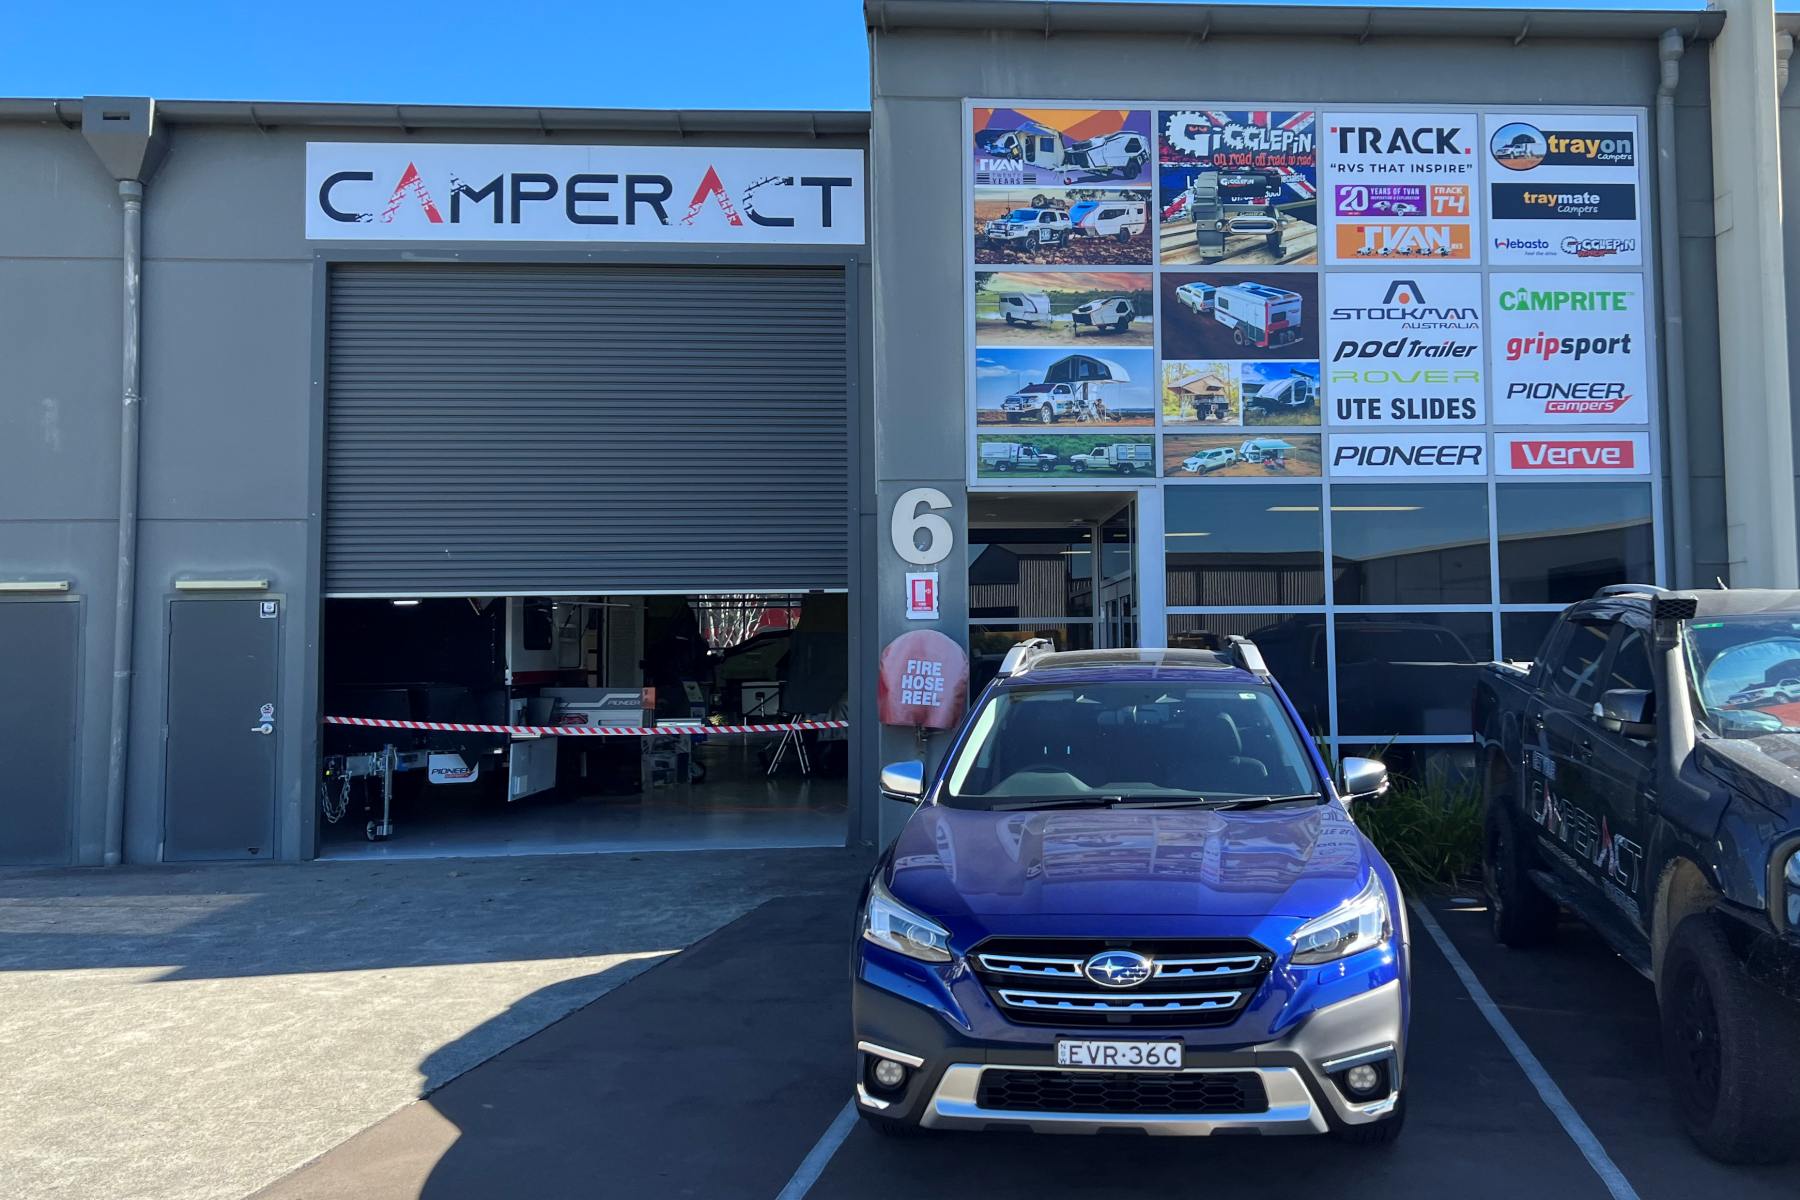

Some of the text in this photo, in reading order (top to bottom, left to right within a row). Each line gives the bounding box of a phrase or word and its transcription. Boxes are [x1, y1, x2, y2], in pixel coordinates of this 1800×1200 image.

[1548, 135, 1631, 158] trayon
[979, 158, 1024, 171] TVAN
[1369, 163, 1406, 173] THAT
[318, 160, 853, 228] CAMPERACT
[1338, 186, 1369, 211] 20
[1370, 187, 1391, 195] YEARS
[1523, 191, 1600, 207] traymate
[1433, 195, 1466, 213] T4
[1360, 226, 1451, 250] TVAN
[1494, 238, 1549, 249] Webasto
[1330, 308, 1479, 320] STOCKMAN
[1401, 322, 1480, 330] AUSTRALIA
[1333, 337, 1408, 363] pod
[1506, 331, 1631, 361] gripsport
[1332, 370, 1480, 384] ROVER
[1507, 382, 1625, 400] PIONEER
[1337, 397, 1477, 420] UTE SLIDES
[1548, 400, 1614, 413] campers
[1334, 445, 1482, 466] PIONEER
[1522, 444, 1621, 466] Verve
[891, 487, 953, 565] 6
[907, 659, 943, 677] FIRE
[901, 675, 945, 691] HOSE
[901, 690, 941, 707] REEL
